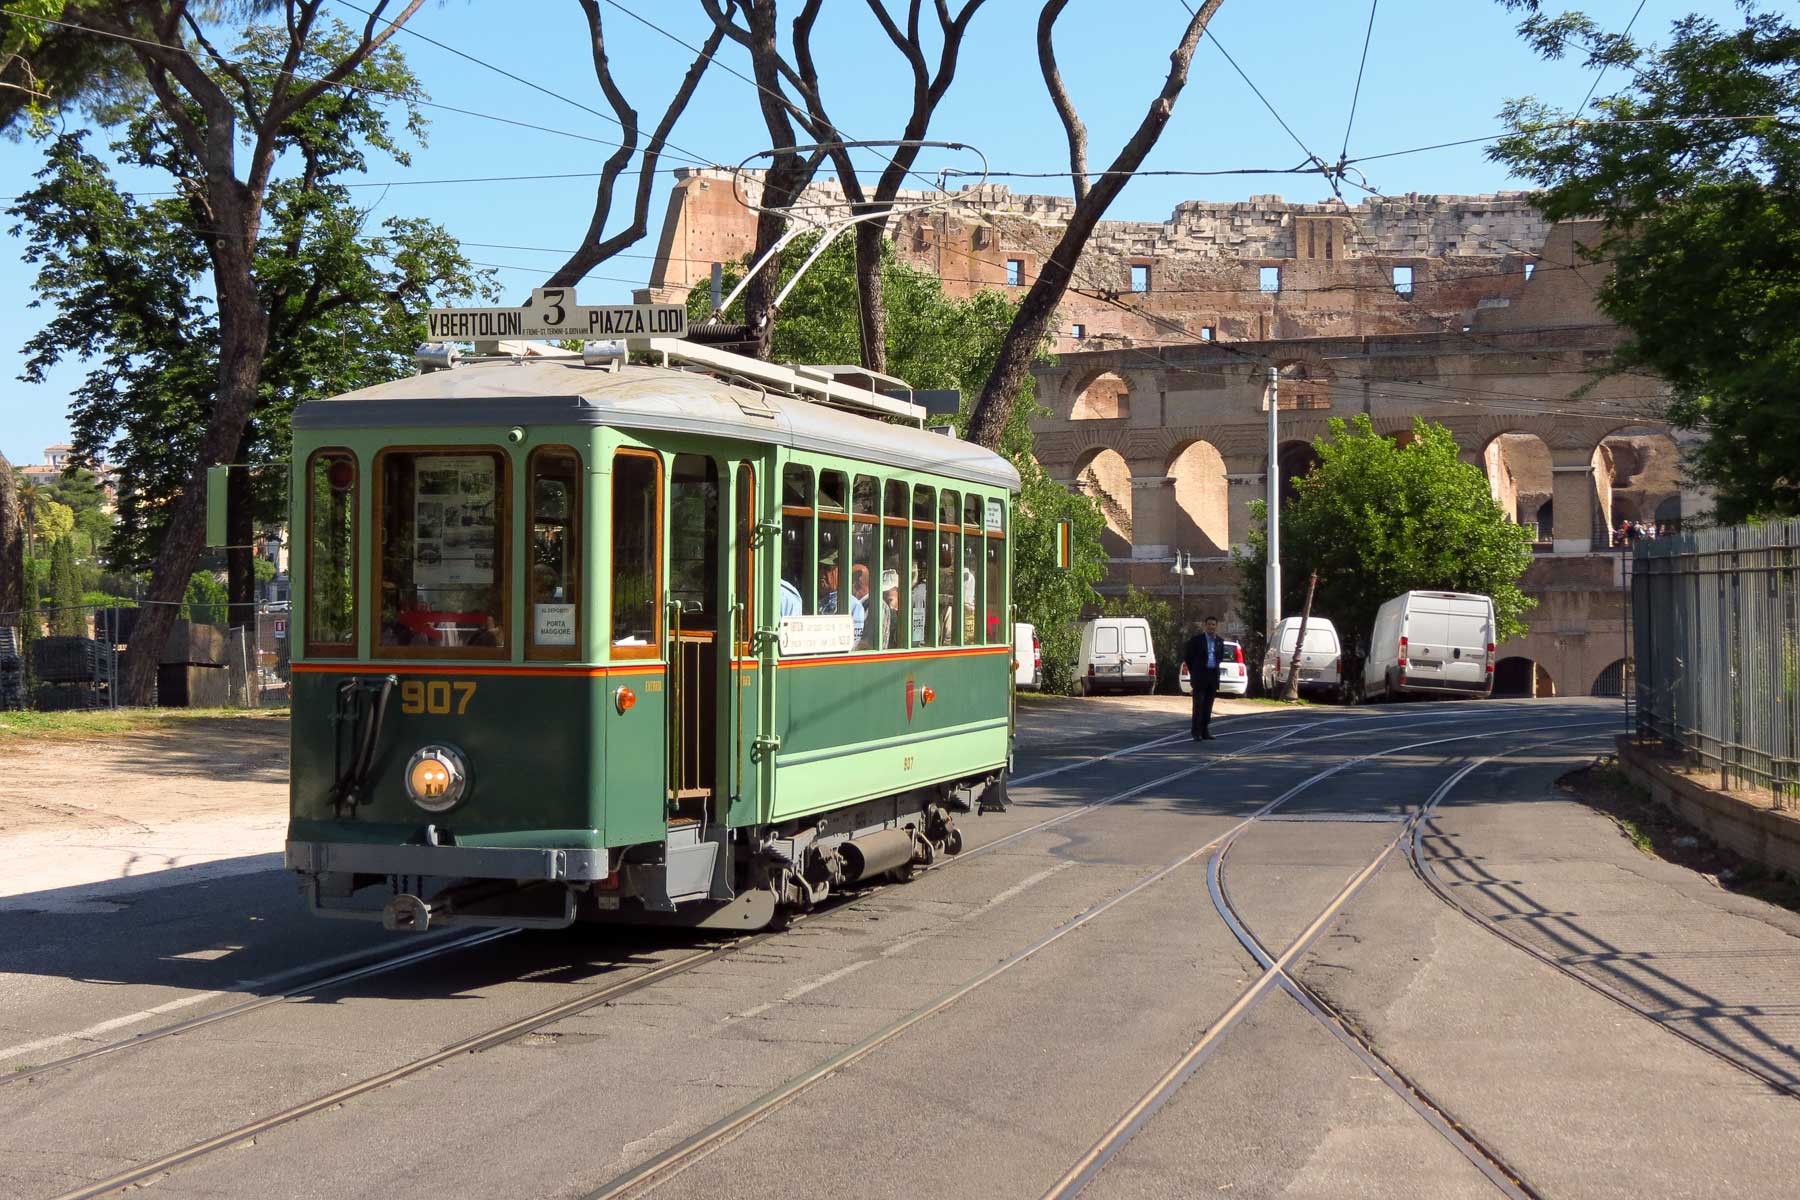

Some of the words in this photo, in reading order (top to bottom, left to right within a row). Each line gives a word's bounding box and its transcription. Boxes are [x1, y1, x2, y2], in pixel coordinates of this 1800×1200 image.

[543, 290, 566, 326] 3
[589, 310, 645, 334] PIAZZA
[649, 309, 684, 333] LODI
[546, 620, 566, 628] PORTA
[402, 681, 477, 714] 907
[903, 756, 914, 771] 907
